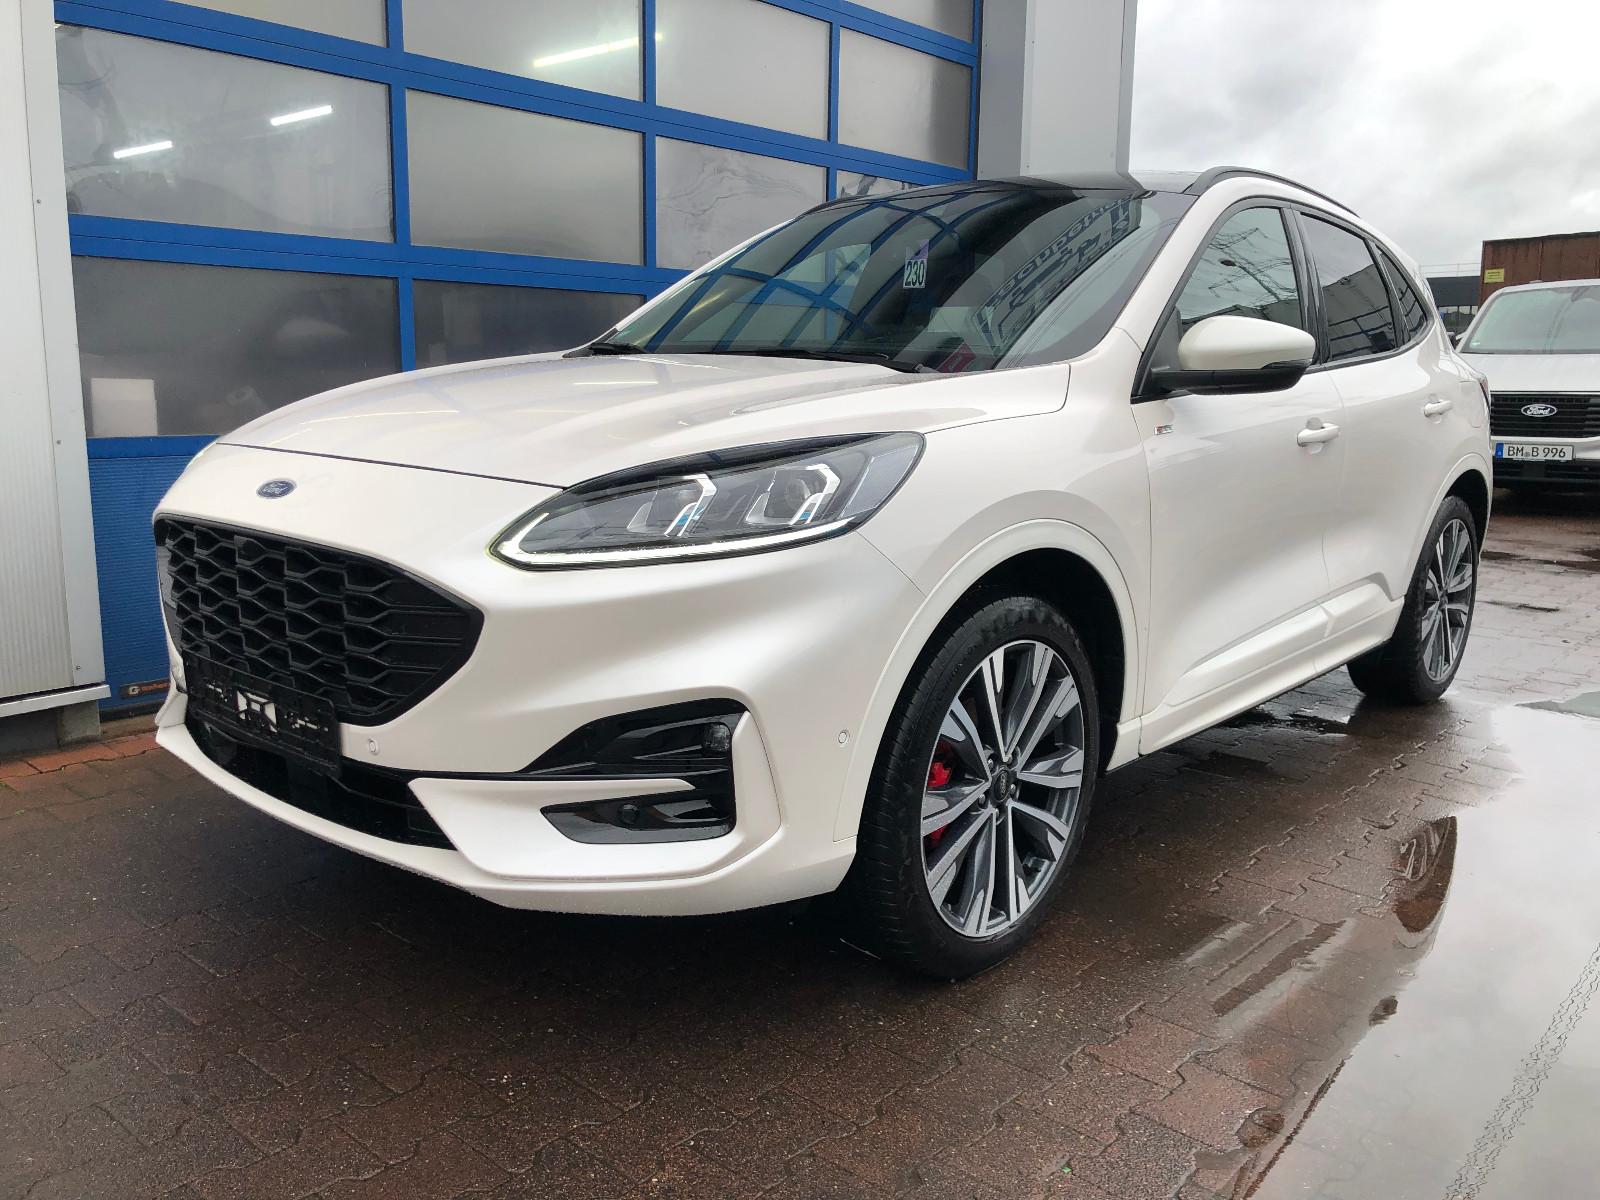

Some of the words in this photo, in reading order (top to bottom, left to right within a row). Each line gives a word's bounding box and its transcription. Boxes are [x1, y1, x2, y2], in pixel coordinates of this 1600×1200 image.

[904, 260, 925, 287] 230
[1525, 405, 1552, 416] Ford
[1507, 446, 1525, 457] BM
[1531, 447, 1540, 457] B
[1543, 447, 1566, 458] 996
[261, 481, 290, 495] Ford
